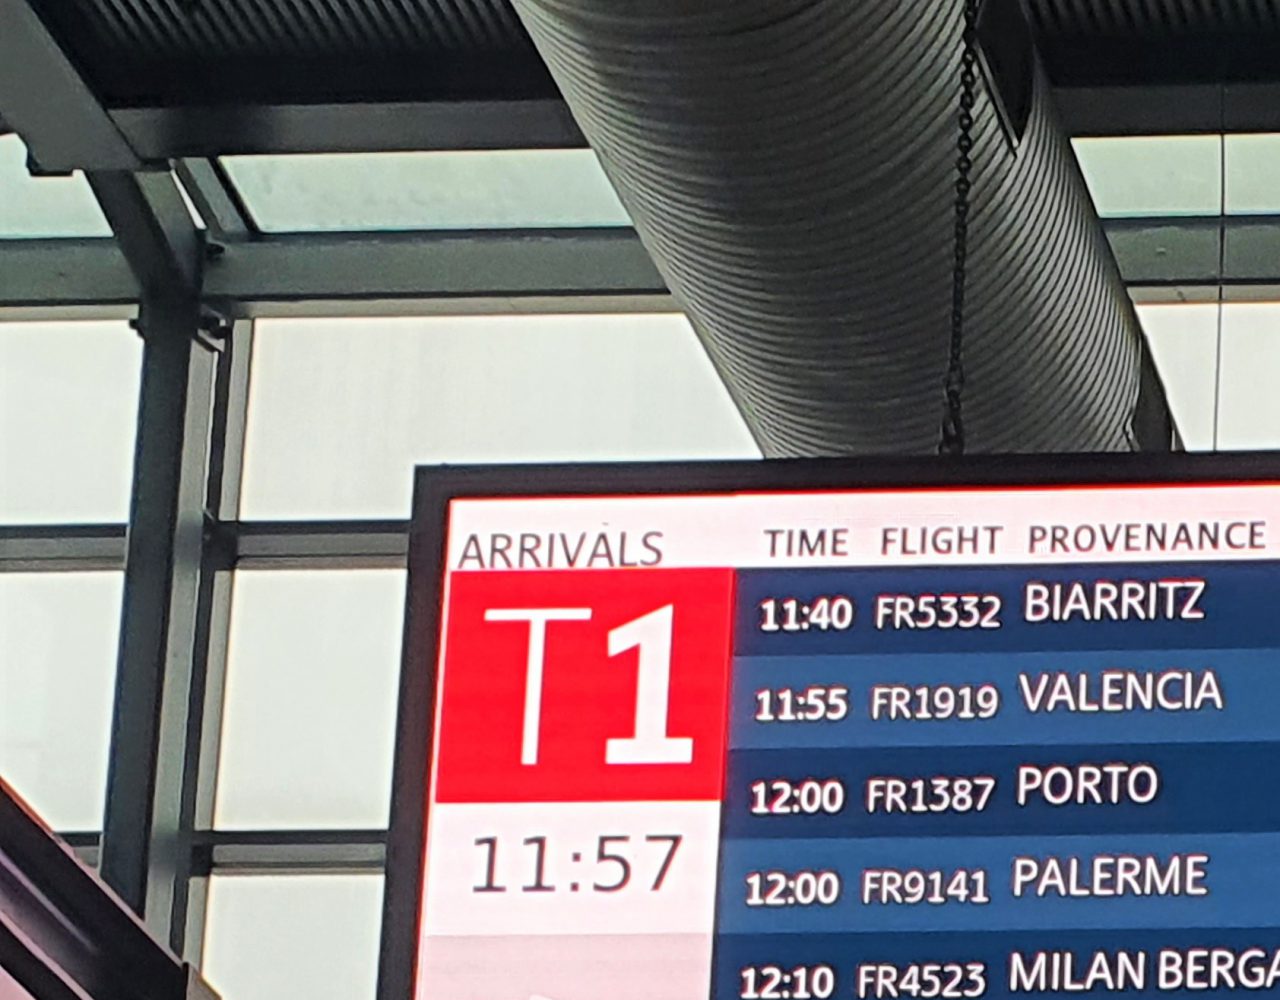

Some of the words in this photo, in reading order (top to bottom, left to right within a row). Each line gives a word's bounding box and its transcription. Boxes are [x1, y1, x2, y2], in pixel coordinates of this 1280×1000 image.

[457, 530, 664, 569] ARRIVALS
[764, 528, 848, 557] TIME
[881, 526, 1003, 555] FLIGHT
[1028, 520, 1267, 554] PROVENANCE
[761, 597, 853, 631] 11:40
[876, 594, 1001, 629] FR5332
[1025, 579, 1206, 622] BIARRITZ
[484, 604, 693, 765] T1
[755, 687, 848, 721] 11:55
[871, 685, 999, 720] FR1919
[1019, 671, 1223, 712] VALENCIA
[751, 781, 844, 814] 12:00
[867, 778, 995, 813] FR1387
[1018, 764, 1158, 805] PORTO
[473, 835, 682, 893] 11:57
[746, 872, 840, 906] 12:00
[862, 870, 989, 904] FR9141
[1013, 855, 1208, 897] PALERME
[740, 967, 834, 999] 12:10
[858, 964, 986, 999] FR4523
[1010, 951, 1146, 991] MILAN
